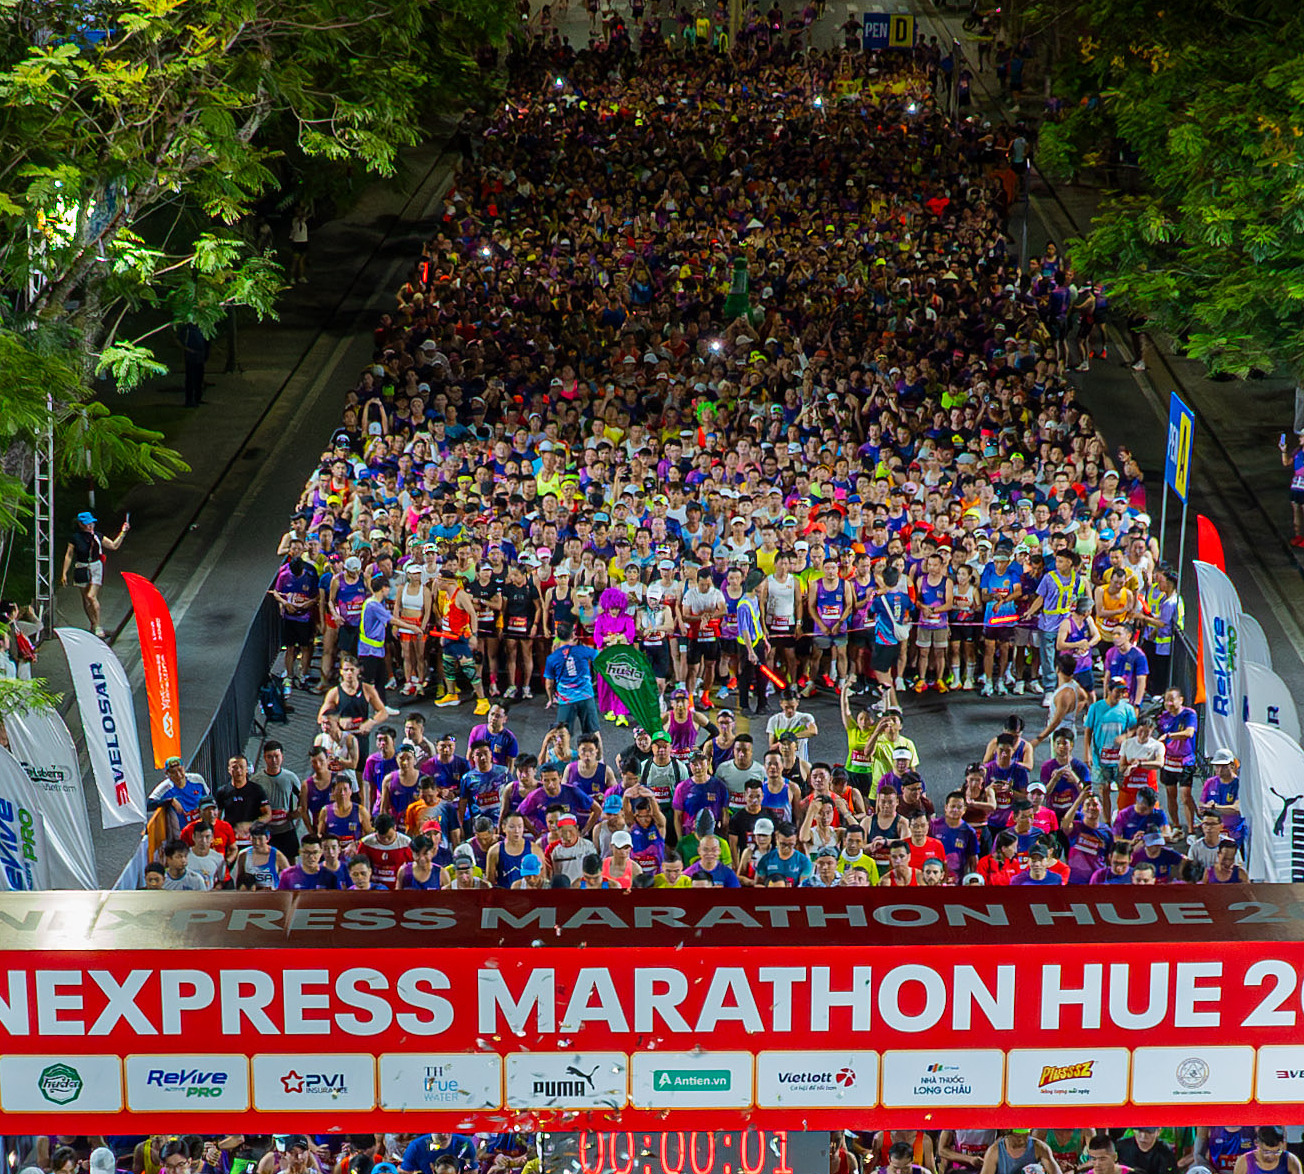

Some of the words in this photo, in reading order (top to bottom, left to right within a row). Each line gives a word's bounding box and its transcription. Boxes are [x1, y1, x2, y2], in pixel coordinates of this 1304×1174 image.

[865, 22, 888, 38] PEN
[896, 18, 907, 41] D
[1168, 422, 1179, 465] PEN
[1178, 425, 1187, 484] A
[89, 662, 126, 784] VELOSAR
[18, 808, 38, 862] PRO
[481, 904, 1009, 930] MARATHON
[1030, 902, 1213, 925] HUE
[477, 963, 1016, 1034] MARATHON
[1041, 961, 1223, 1029] HUE
[147, 1069, 228, 1086] ReVive
[425, 1067, 444, 1077] TH
[778, 1072, 833, 1083] Vietlott
[306, 1074, 345, 1087] PVI
[674, 1075, 727, 1087] Antien.vn
[187, 1087, 223, 1098] PRO
[534, 1081, 585, 1097] PUMA
[914, 1086, 941, 1095] LONG
